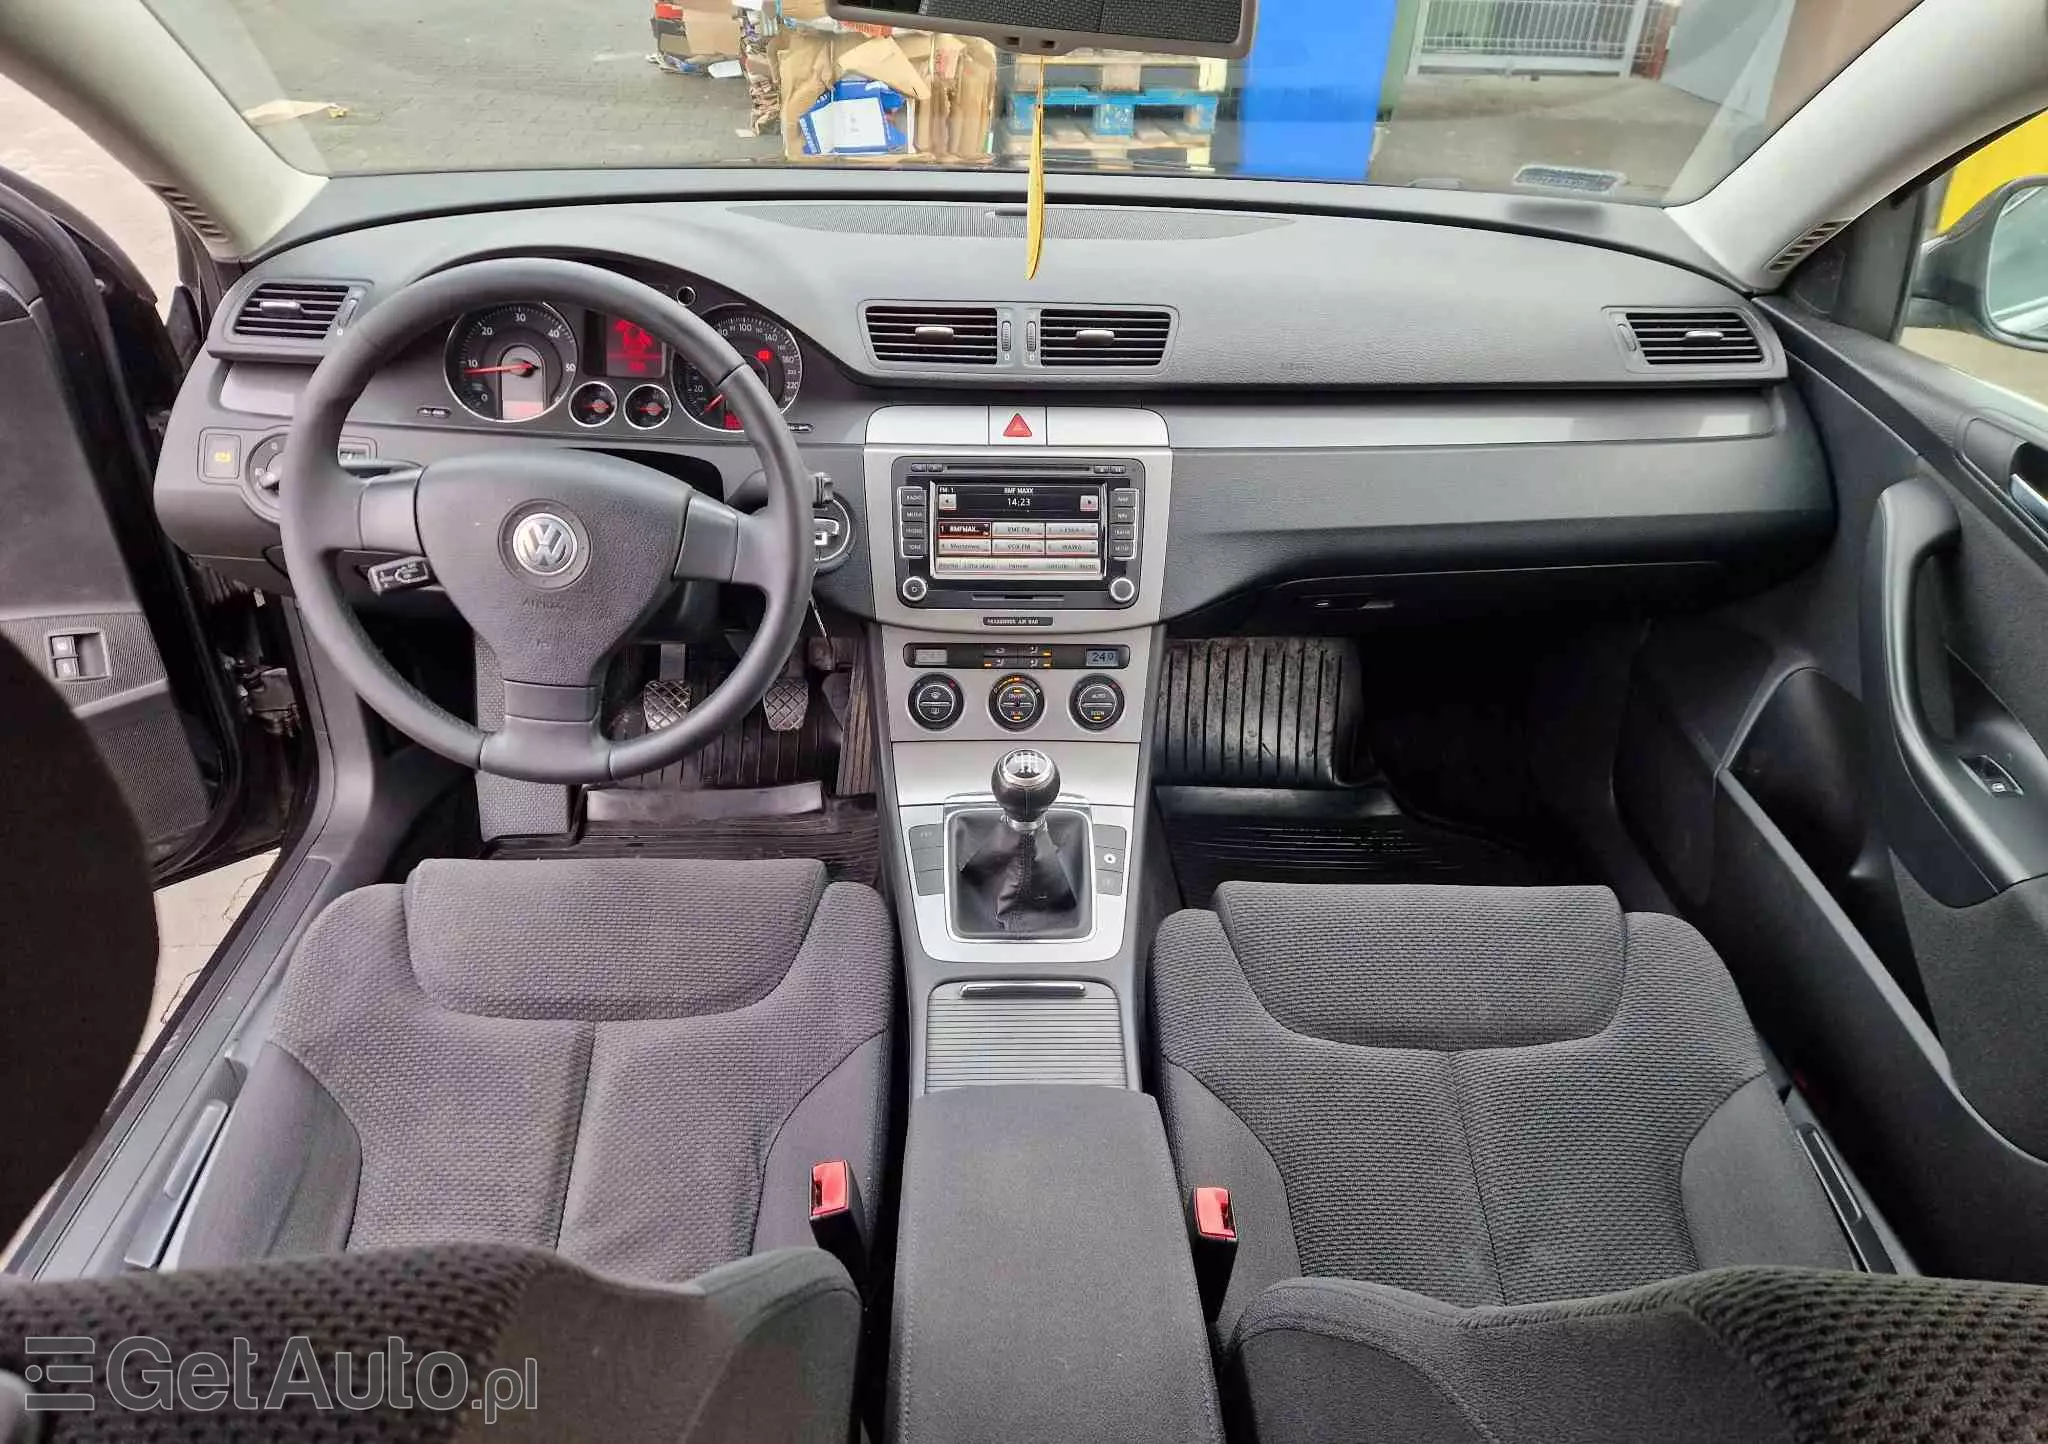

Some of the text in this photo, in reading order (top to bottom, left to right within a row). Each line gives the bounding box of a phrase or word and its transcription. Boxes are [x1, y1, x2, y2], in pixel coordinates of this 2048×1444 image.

[514, 312, 526, 322] 30
[481, 326, 493, 336] 20
[739, 323, 752, 332] 100
[547, 328, 560, 338] 40
[764, 333, 778, 342] 140
[467, 359, 479, 368] 10
[565, 362, 577, 372] 50
[480, 393, 489, 402] 0
[1007, 497, 1031, 507] 14:23
